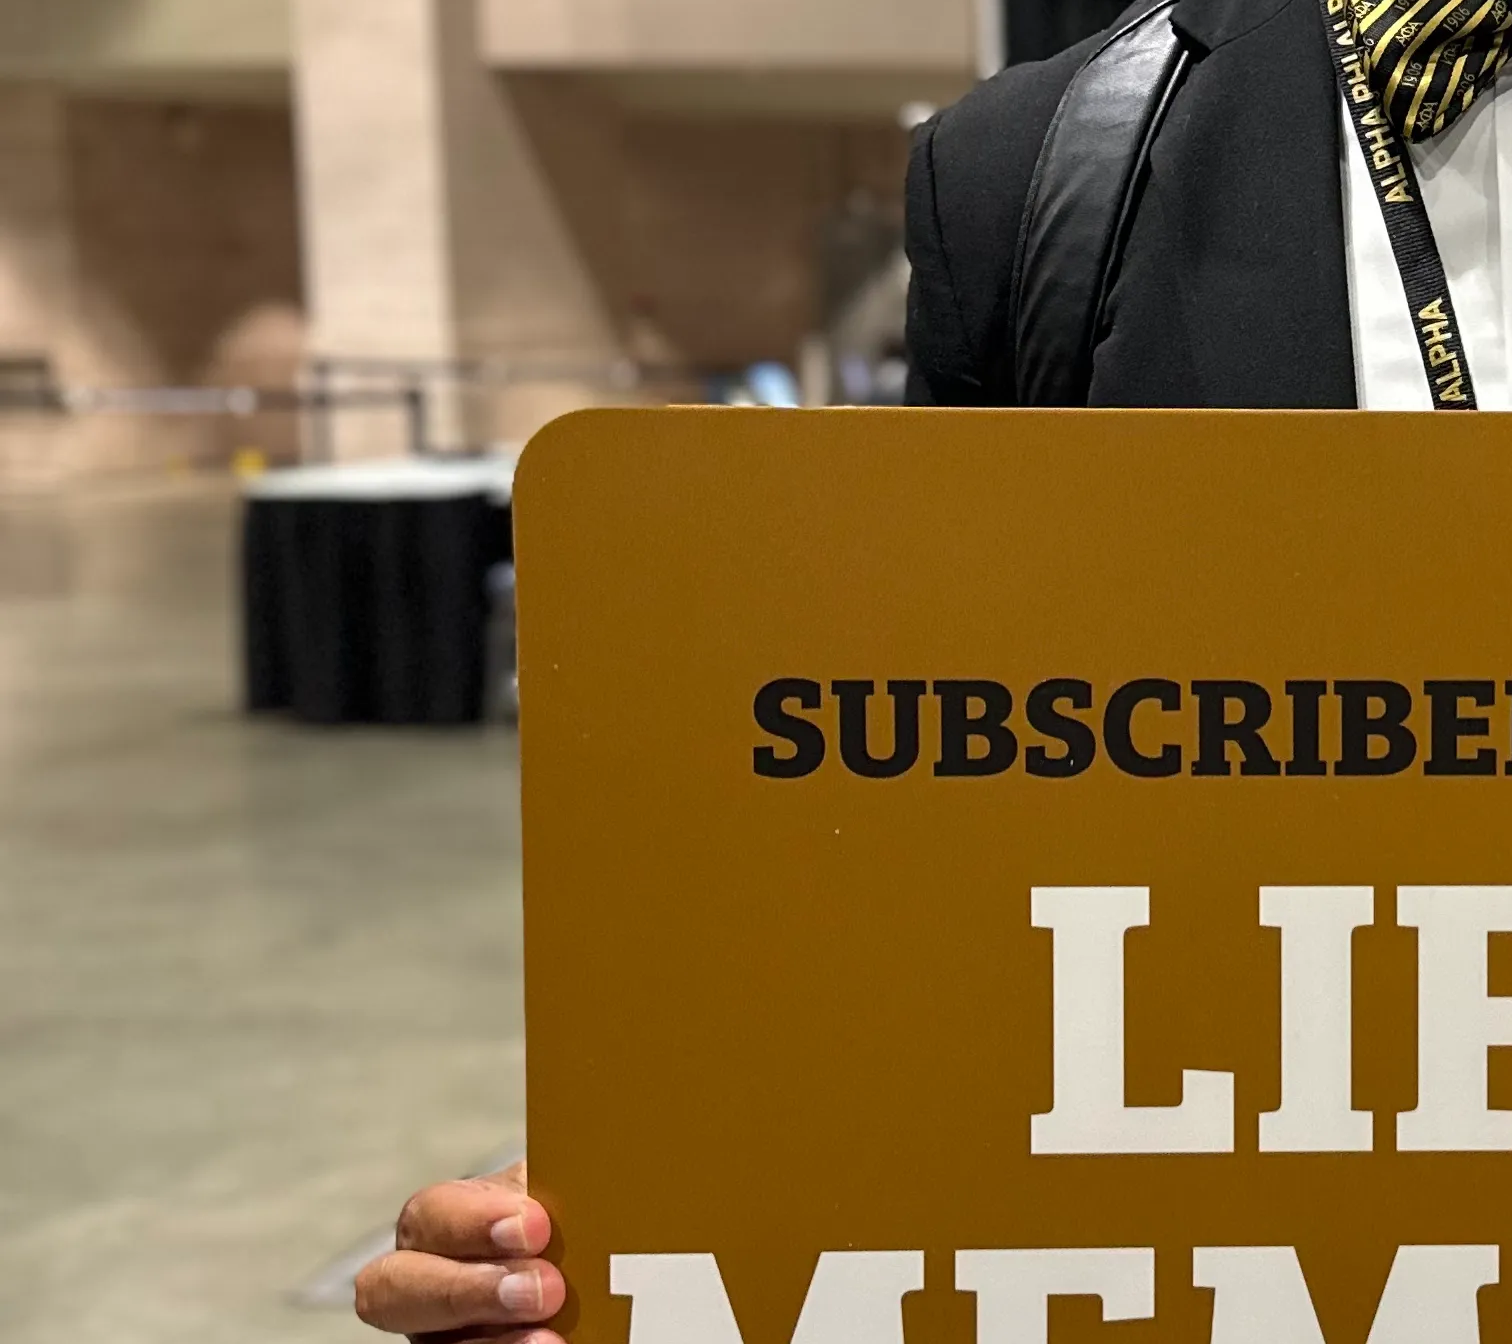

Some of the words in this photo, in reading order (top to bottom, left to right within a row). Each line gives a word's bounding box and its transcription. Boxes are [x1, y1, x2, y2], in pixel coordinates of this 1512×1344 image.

[1443, 6, 1471, 33] 1906
[1341, 52, 1373, 104] PHI
[1361, 105, 1415, 203] ALPHA
[1418, 296, 1466, 401] ALPHA
